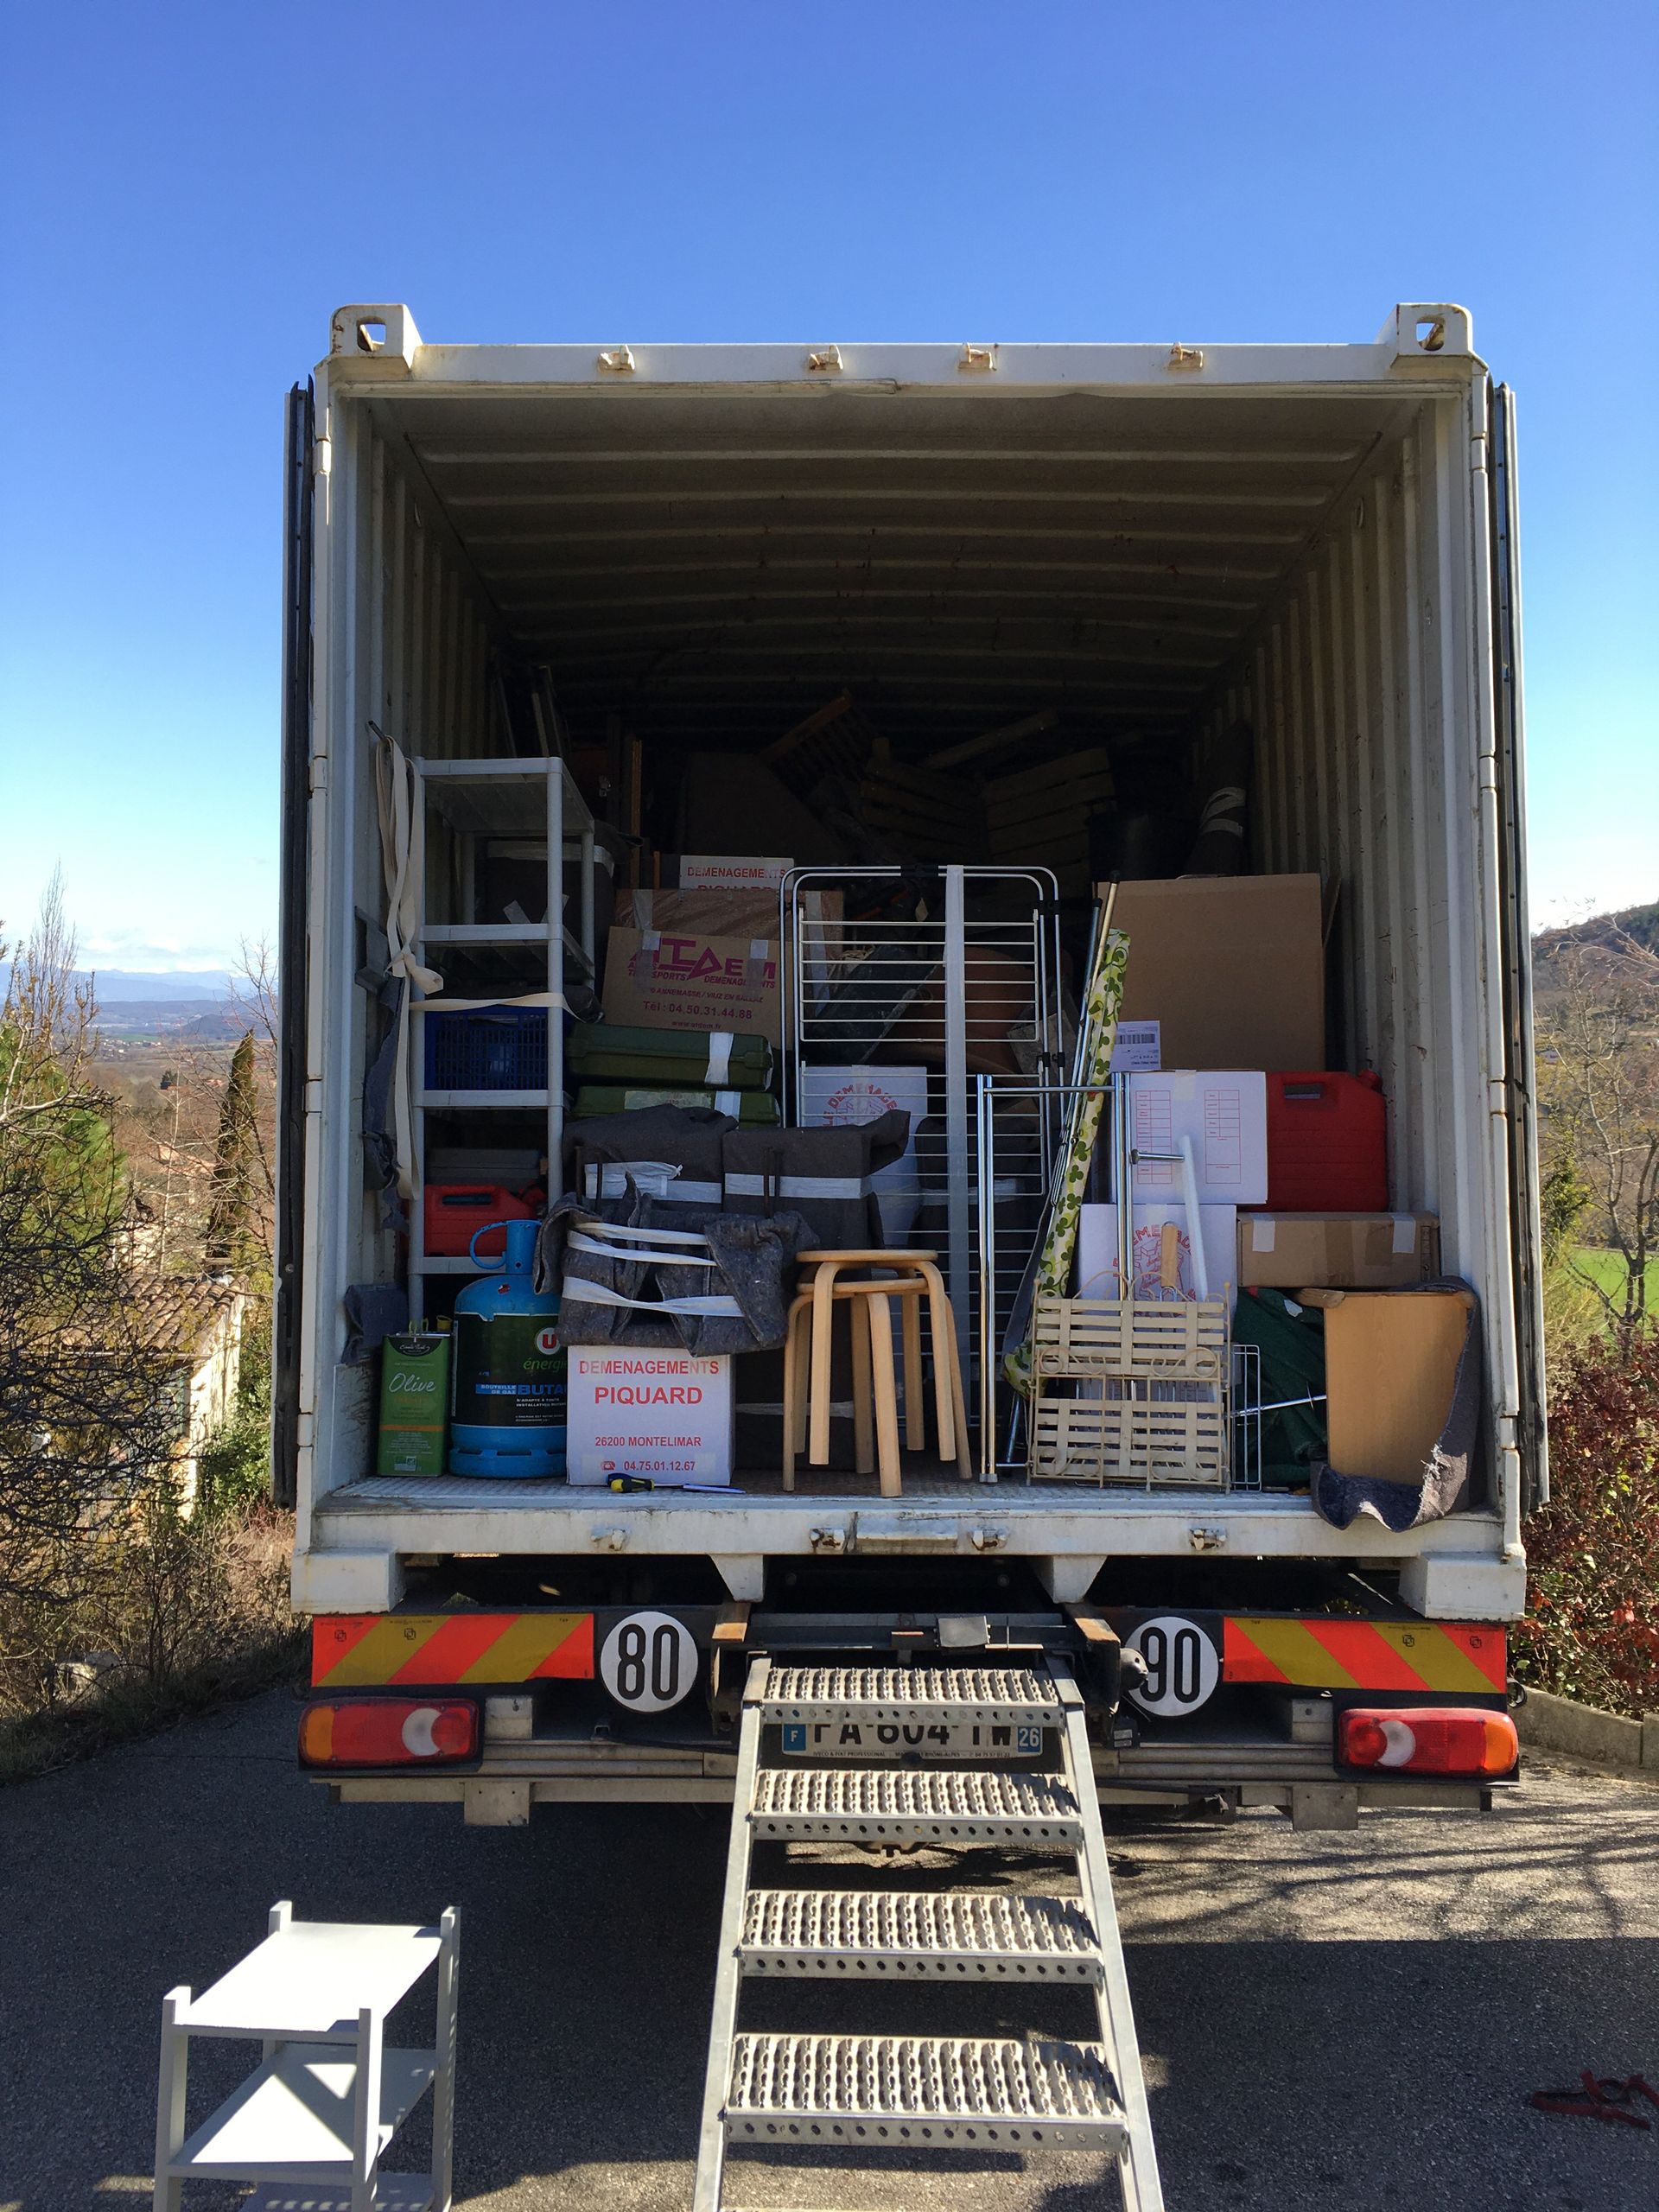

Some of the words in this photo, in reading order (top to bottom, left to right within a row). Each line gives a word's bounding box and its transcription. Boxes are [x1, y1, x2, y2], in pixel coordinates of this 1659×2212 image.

[542, 1333, 557, 1349] U
[523, 1357, 568, 1374] énergi
[579, 1360, 720, 1375] DEMENAGEMENTS
[389, 1372, 437, 1393] Olive
[518, 1384, 568, 1395] BUTA
[594, 1386, 703, 1406] PIQUARD
[594, 1436, 626, 1447] 26200
[628, 1436, 702, 1447] MONTELIMAR
[623, 1460, 696, 1471] 04.75.01.12.67
[617, 1623, 680, 1701] 80
[1140, 1626, 1201, 1704] 90
[1018, 1727, 1040, 1748] 26
